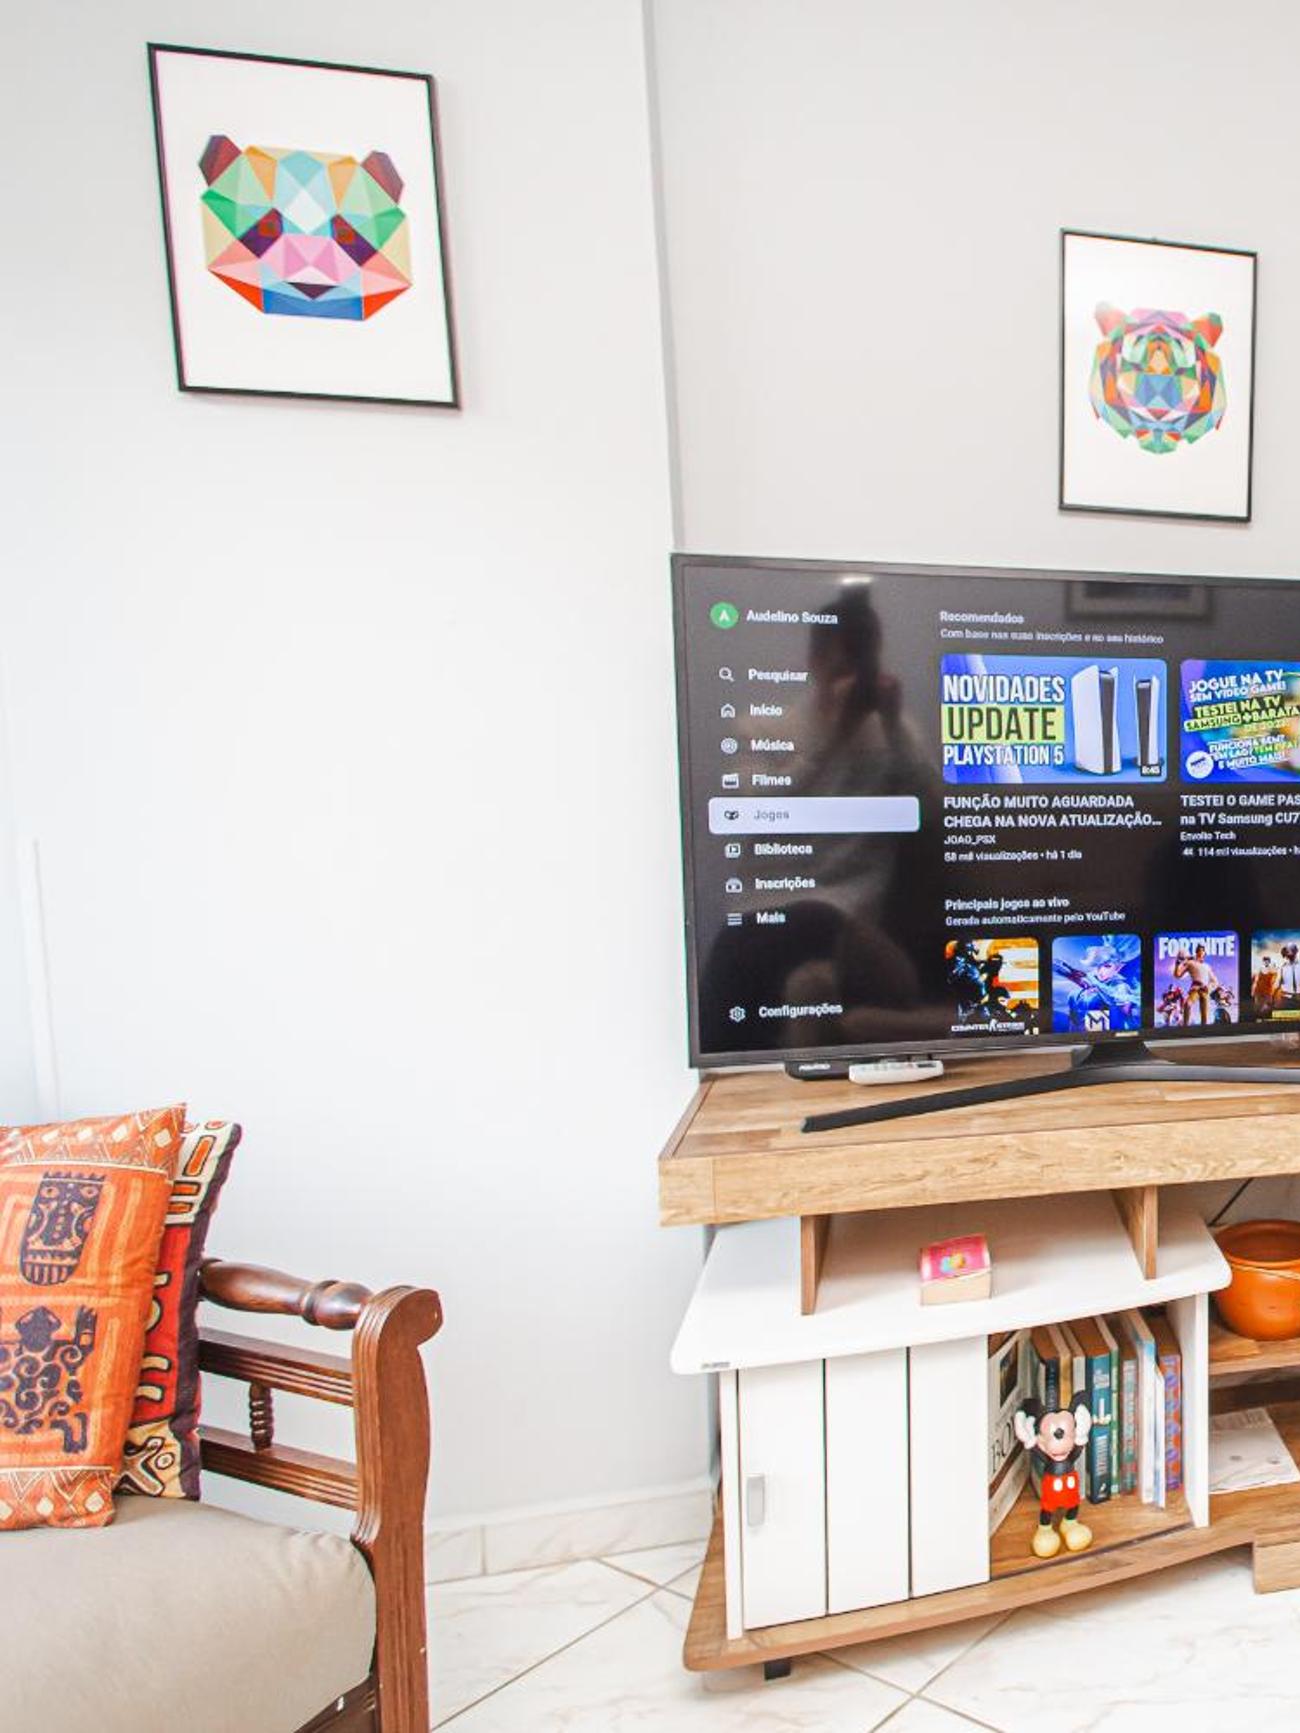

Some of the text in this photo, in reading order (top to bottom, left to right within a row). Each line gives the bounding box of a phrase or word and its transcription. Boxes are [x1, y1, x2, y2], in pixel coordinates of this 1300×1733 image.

[720, 609, 730, 621] A
[802, 611, 838, 624] Souza
[940, 611, 1024, 624] Recomendados
[748, 669, 808, 683] Pesquisar
[1189, 669, 1284, 694] JOGUE NA TV
[943, 675, 1065, 703] NOVIDADES
[750, 702, 783, 716] Início
[1194, 695, 1281, 718] TESTEI NA TV
[948, 706, 1057, 741] UPDATE
[1186, 714, 1241, 731] SAMSUNG
[751, 737, 795, 751] Música
[943, 745, 1064, 766] PLAYSTATION 5
[752, 773, 792, 786] Filmes
[944, 793, 1134, 811] FUNÇÃO MUITO AGUARDADA
[1181, 794, 1224, 807] TESTEI
[1227, 794, 1236, 806] O
[1239, 794, 1275, 806] GAME
[754, 809, 790, 823] Jogos
[944, 815, 992, 828] CHEGA
[994, 815, 1016, 828] NA
[1019, 814, 1057, 827] NOVA
[1181, 815, 1195, 825] na
[1199, 813, 1215, 824] TV
[1218, 814, 1273, 826] Samsung
[754, 843, 813, 855] Biblioteca
[975, 850, 1038, 863] visualizações
[1067, 849, 1082, 860] dia
[755, 876, 816, 891] Inscrições
[945, 898, 999, 912] Principais
[1000, 897, 1030, 911] jogos
[1047, 896, 1070, 908] vivo
[756, 912, 786, 924] Mais
[982, 913, 1063, 924] automaticamente
[1064, 912, 1084, 924] pelo
[1085, 910, 1126, 921] YouTube
[1158, 935, 1236, 959] FORTNITE
[759, 1003, 842, 1018] Configurações
